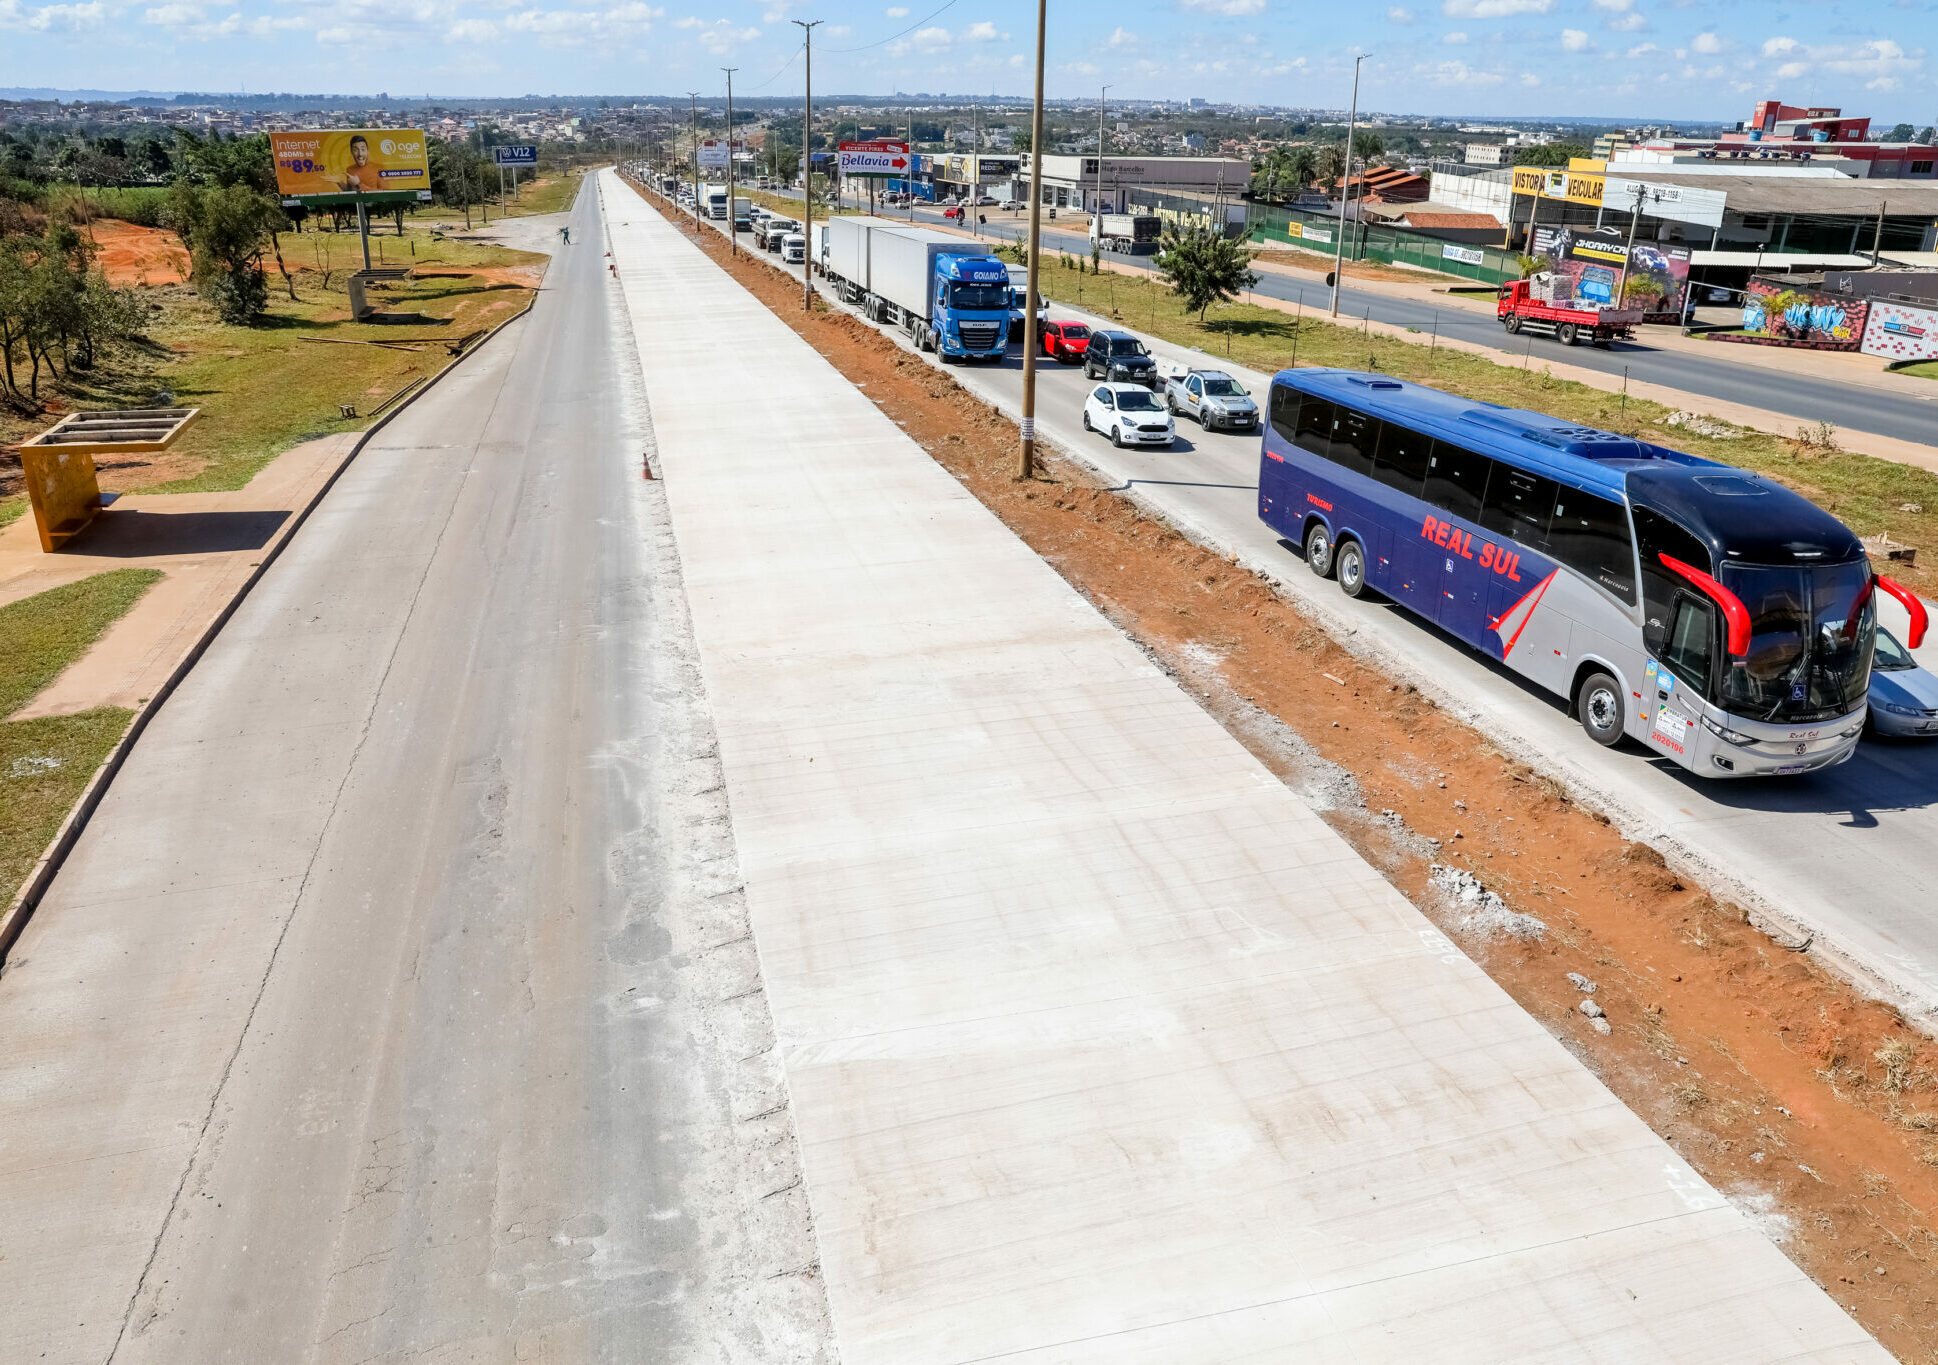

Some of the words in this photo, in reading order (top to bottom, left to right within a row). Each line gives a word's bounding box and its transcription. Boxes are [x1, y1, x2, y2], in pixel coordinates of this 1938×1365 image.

[275, 139, 321, 150] Internet
[398, 142, 420, 153] age
[512, 147, 530, 157] V12
[841, 153, 890, 167] Bellavia
[1567, 178, 1604, 201] VEICULAR
[973, 271, 999, 281] GOIANO
[1832, 325, 1851, 340] CAR
[1306, 493, 1333, 513] TURISMO
[1420, 514, 1474, 560] REAL
[1478, 541, 1522, 583] SUL
[1603, 577, 1629, 592] Marcopolo
[1789, 731, 1806, 739] Real
[1651, 731, 1685, 755] 2020196
